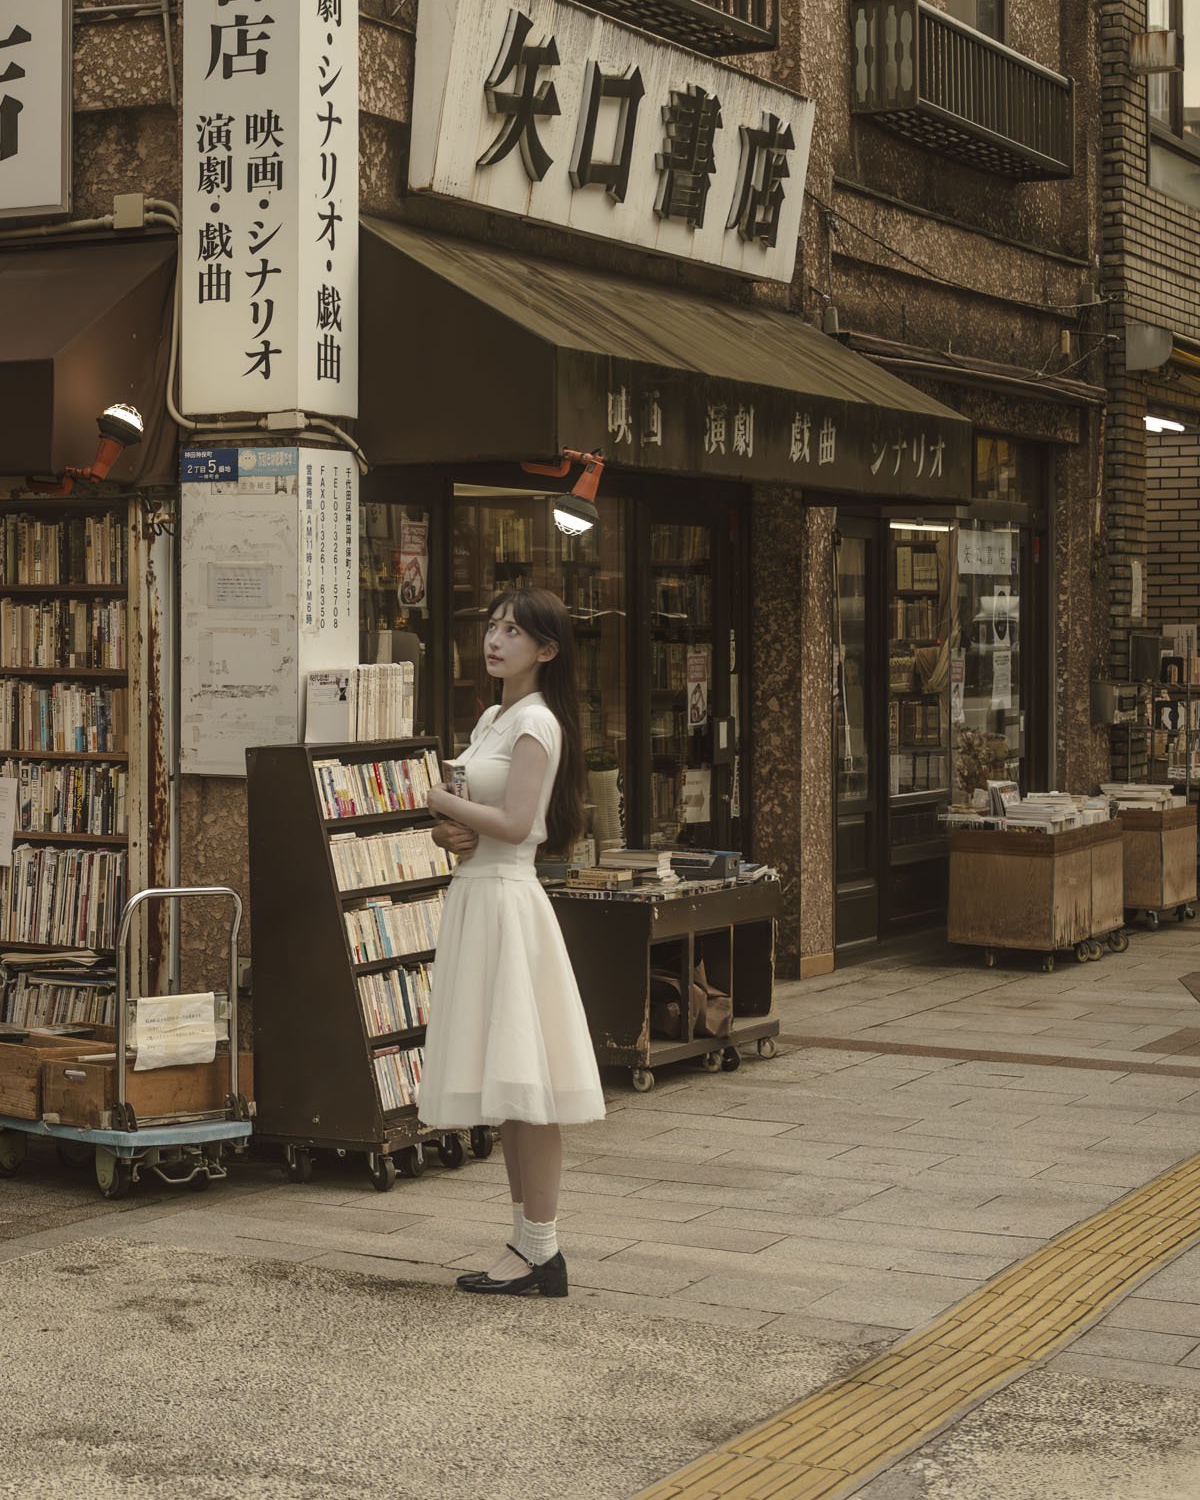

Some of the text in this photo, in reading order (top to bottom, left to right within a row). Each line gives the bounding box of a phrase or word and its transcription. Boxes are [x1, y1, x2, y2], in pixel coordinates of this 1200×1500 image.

[196, 113, 235, 304] 演劇・戯曲
[476, 8, 796, 248] 矢口書店
[242, 108, 283, 379] 映画・シナリオ
[184, 451, 213, 459] 神田神保町
[607, 386, 945, 478] 映画 演劇 戯曲 シナリオ
